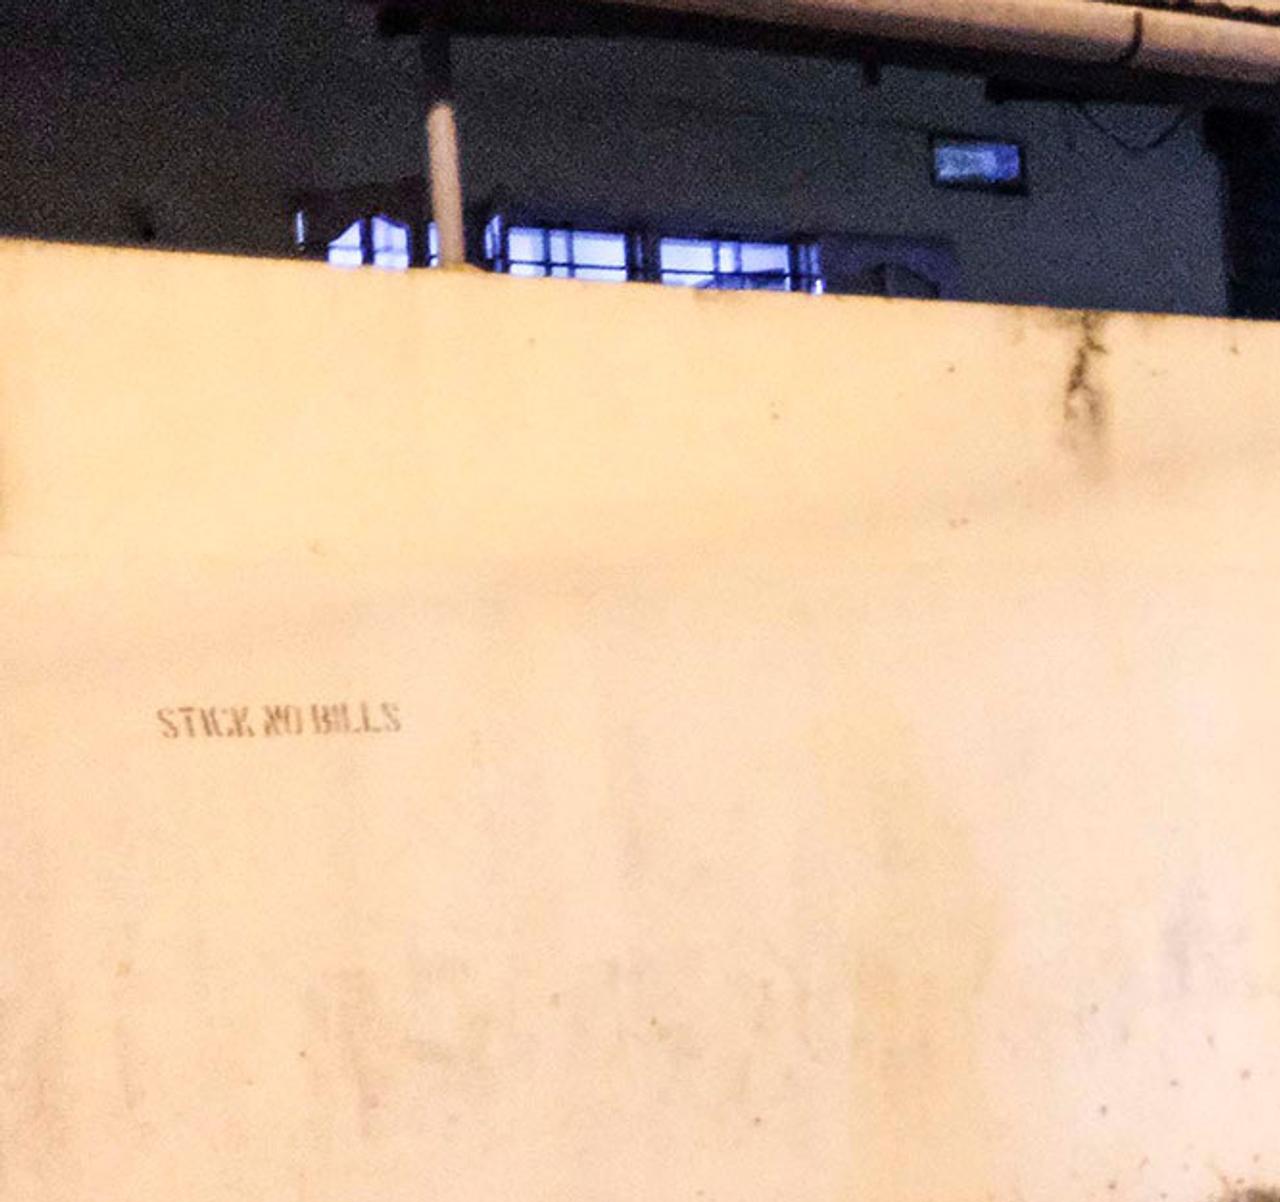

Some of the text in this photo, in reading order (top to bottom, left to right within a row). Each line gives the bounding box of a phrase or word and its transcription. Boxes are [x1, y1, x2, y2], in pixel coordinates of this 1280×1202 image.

[157, 701, 402, 739] STICK NO BILLS
